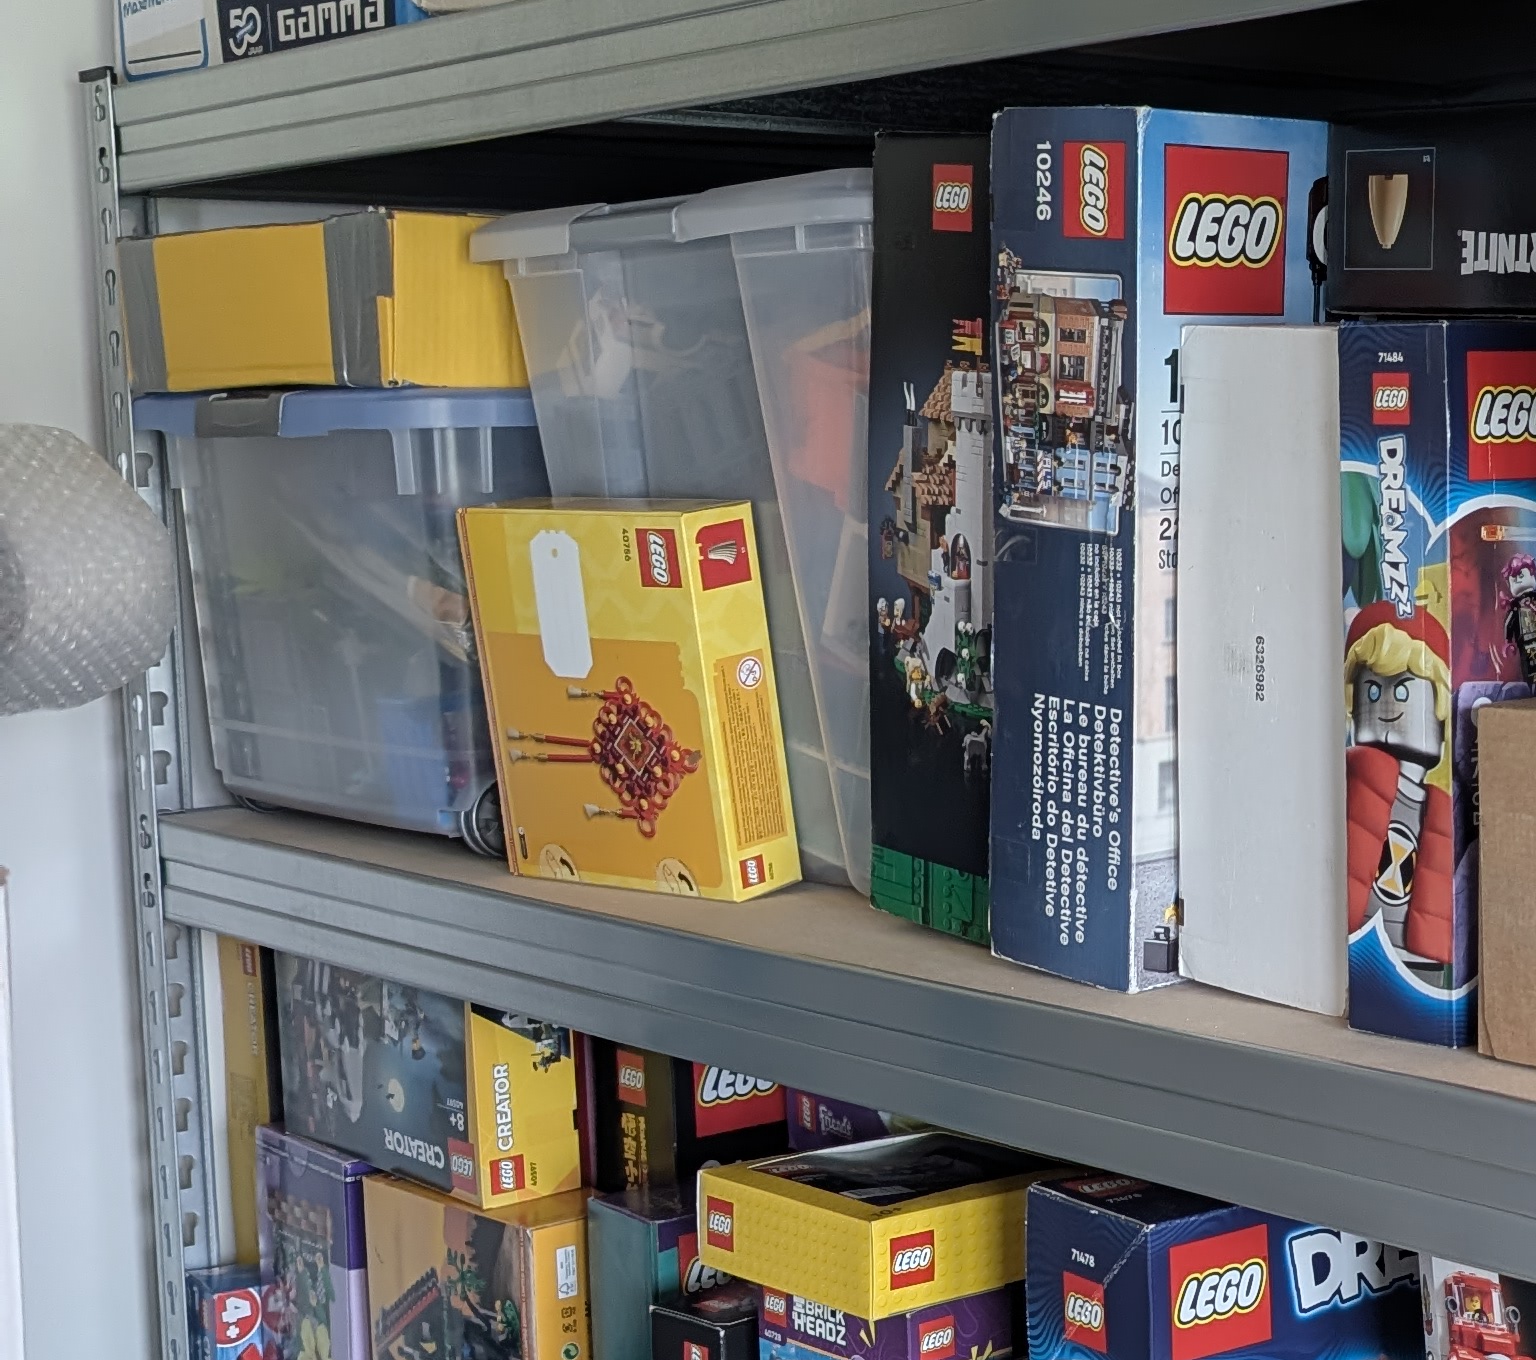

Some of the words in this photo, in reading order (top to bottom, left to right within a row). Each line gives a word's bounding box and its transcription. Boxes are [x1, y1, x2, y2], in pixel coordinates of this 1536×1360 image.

[934, 183, 971, 212] LEGO
[1034, 140, 1053, 221] 10246
[1080, 144, 1108, 236] LEGO
[1170, 193, 1283, 268] LEGO
[1377, 351, 1405, 364] 71484
[1373, 385, 1409, 410] LEGO
[645, 530, 668, 586] LEGO
[1255, 635, 1265, 703] 6326982
[1062, 698, 1075, 724] La
[1078, 702, 1091, 728] Le
[1047, 695, 1061, 793] Escritório
[1030, 693, 1046, 841] Nyomozóiroda
[1061, 729, 1076, 804] Oficina
[1077, 734, 1090, 807] bureau
[1093, 705, 1107, 838] Detektivbüro
[1108, 709, 1123, 824] Detective's
[1046, 800, 1058, 827] do
[1060, 809, 1073, 841] del
[1076, 815, 1089, 842] du
[743, 857, 762, 887] LEGO
[1044, 835, 1058, 917] Detetive
[1106, 830, 1123, 891] Office
[1059, 848, 1073, 946] Detective
[1076, 848, 1089, 944] détective
[619, 1067, 645, 1090] LEGO
[449, 1112, 465, 1132] 8+
[491, 1062, 515, 1152] CREATOR
[384, 1126, 445, 1170] CREATOR
[450, 1151, 473, 1178] LEGO
[500, 1159, 514, 1191] LEGO
[708, 1213, 732, 1237] LEGO
[891, 1244, 934, 1277] LEGO
[1070, 1248, 1096, 1268] 71478
[763, 1292, 787, 1314] LEGO
[1173, 1258, 1267, 1329] LEGO
[805, 1297, 846, 1327] BRICK
[1065, 1293, 1105, 1331] LEGO
[920, 1325, 954, 1354] LEGO
